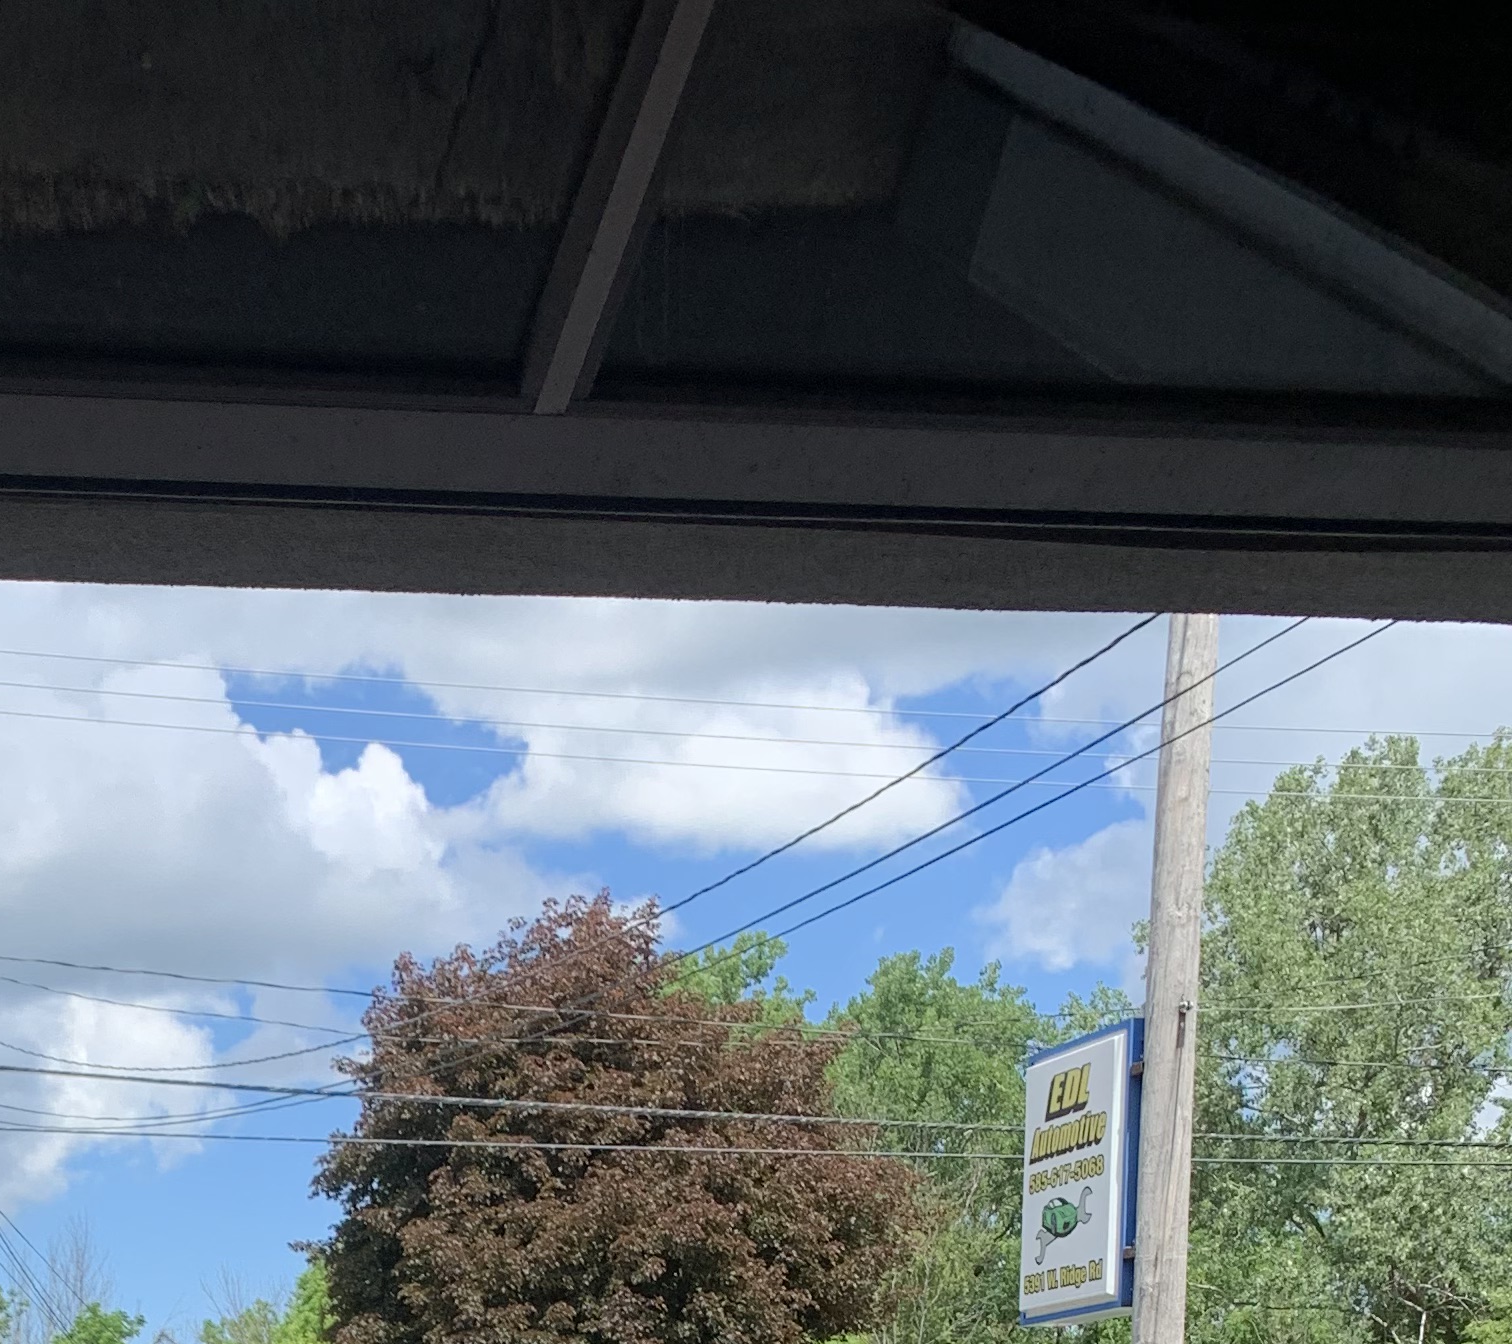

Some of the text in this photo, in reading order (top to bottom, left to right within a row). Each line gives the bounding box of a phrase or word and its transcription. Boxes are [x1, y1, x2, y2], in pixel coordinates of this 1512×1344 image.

[1045, 1062, 1091, 1122] EDL
[1029, 1111, 1107, 1165] Automotive
[1029, 1154, 1104, 1195] 585-617-5068
[1024, 1271, 1044, 1295] 5391
[1060, 1264, 1087, 1288] Ridge
[1089, 1258, 1103, 1282] Rd
